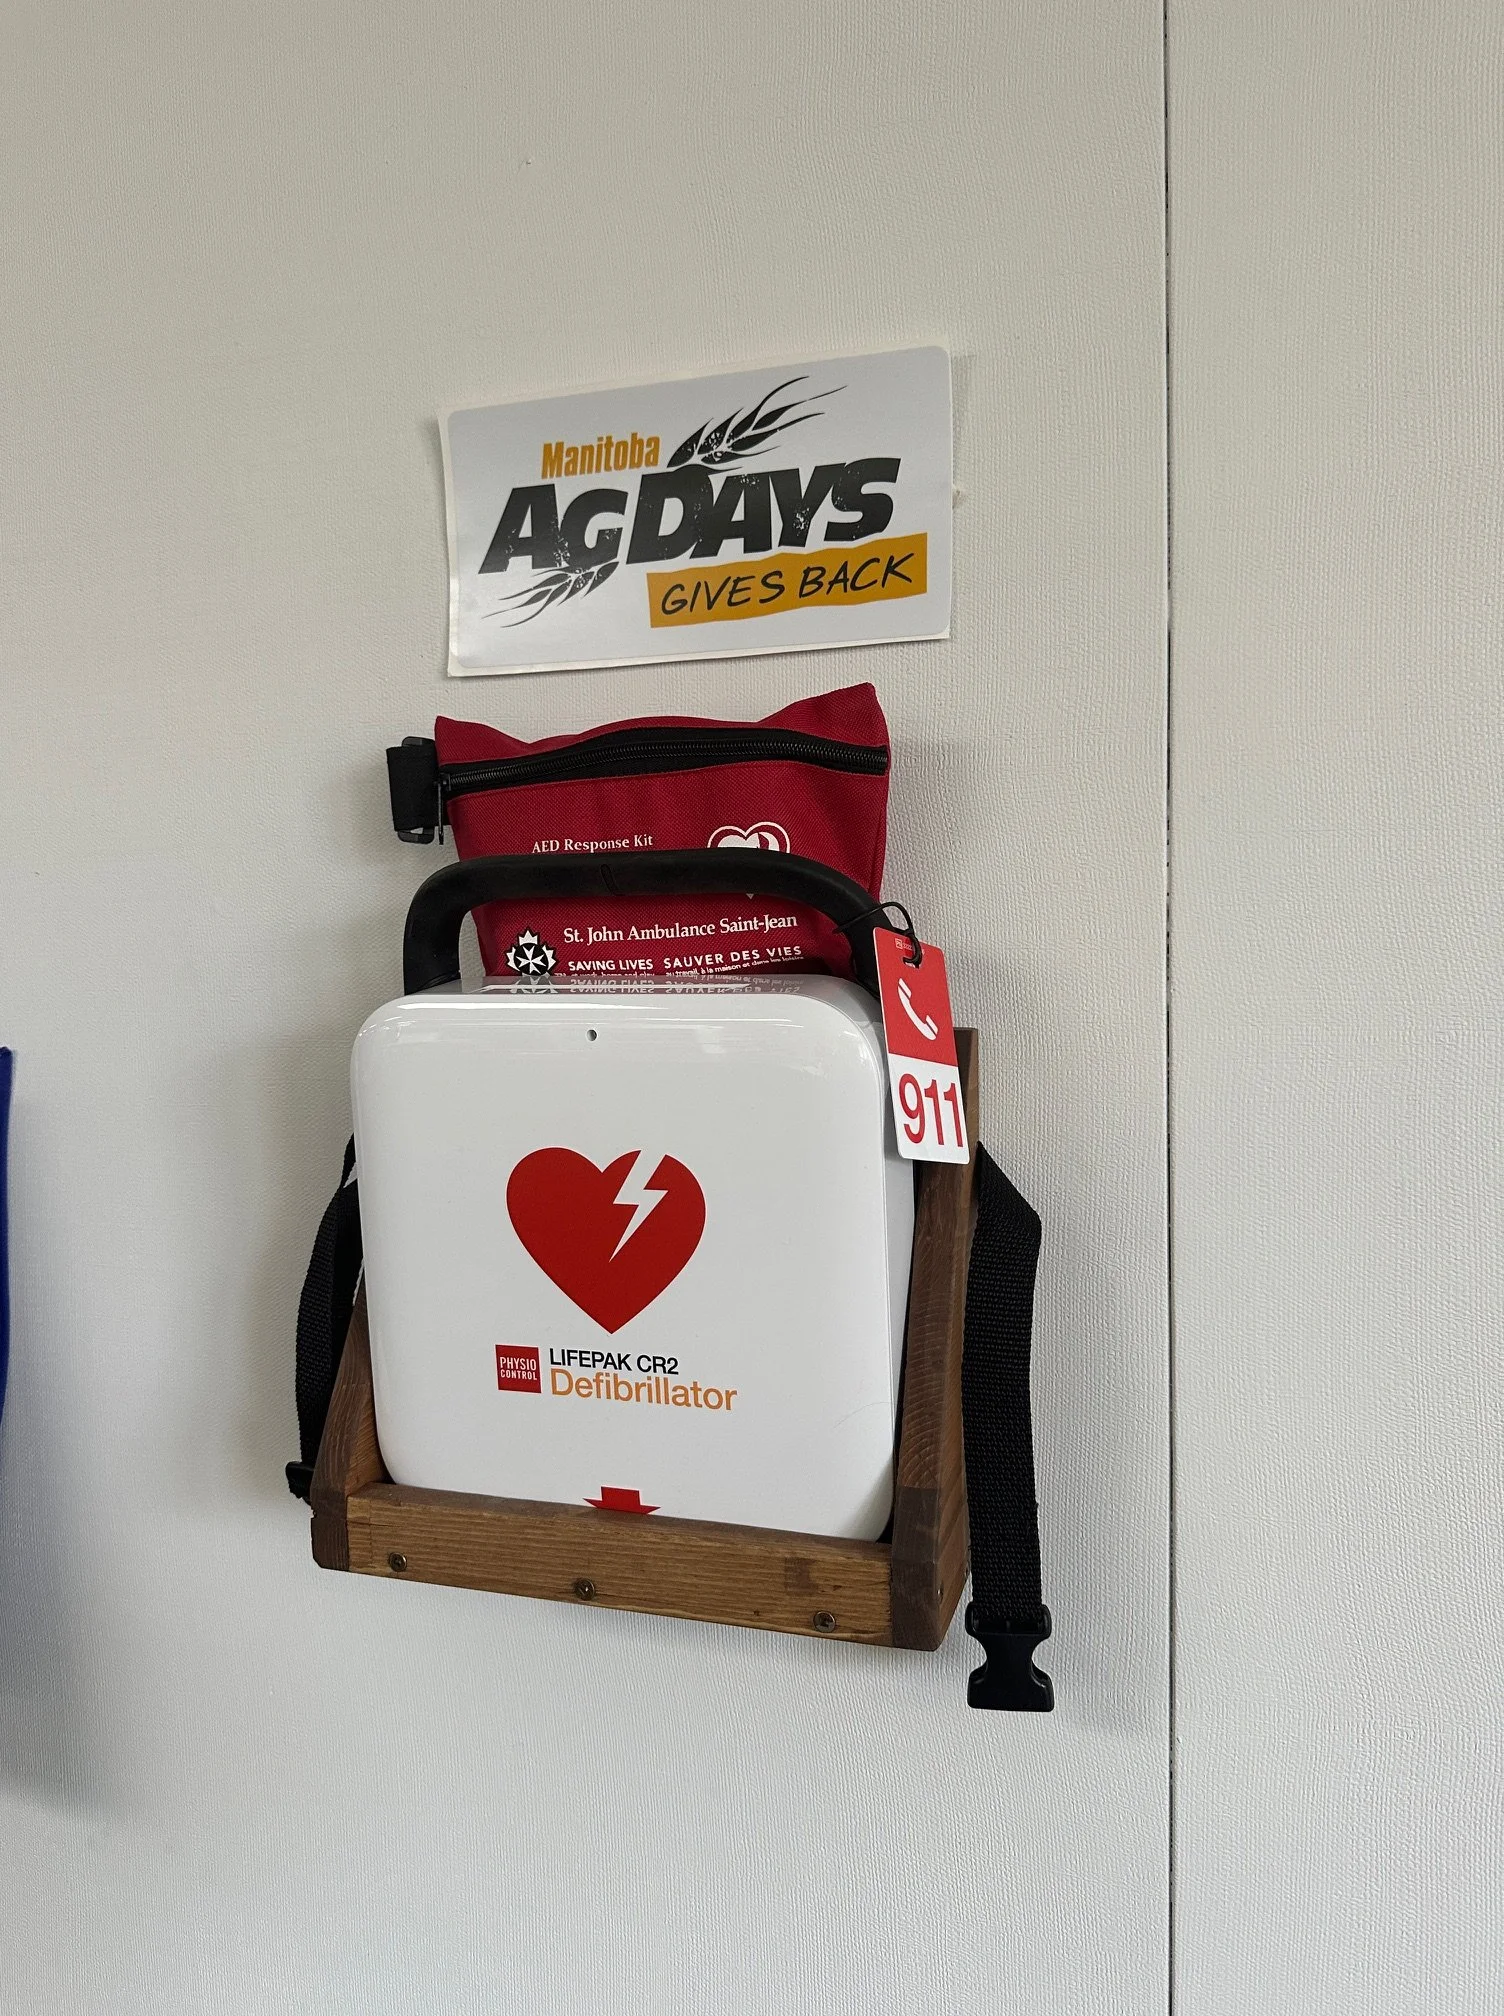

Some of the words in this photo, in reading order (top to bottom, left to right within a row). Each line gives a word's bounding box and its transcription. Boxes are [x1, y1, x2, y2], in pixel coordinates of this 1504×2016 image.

[541, 432, 661, 479] Manitoba
[660, 572, 786, 616] GIVES
[798, 552, 915, 599] BACK
[532, 839, 560, 854] AED
[564, 838, 630, 854] Response
[634, 833, 654, 847] Kit
[563, 927, 584, 944] St.
[587, 926, 624, 946] John
[627, 921, 716, 941] Ambulance
[719, 913, 798, 934] Saint-Jean
[568, 960, 616, 971] SAVING
[619, 959, 654, 971] LIVES
[663, 952, 724, 969] SAUVER
[730, 949, 761, 963] DES
[766, 945, 802, 958] VIES
[899, 1073, 964, 1148] 911
[499, 1356, 537, 1371] PHYSIO
[500, 1369, 538, 1381] CONTROL
[549, 1348, 632, 1371] LIFEPAK
[636, 1354, 679, 1375] CR2
[550, 1368, 738, 1410] Defibrillator
